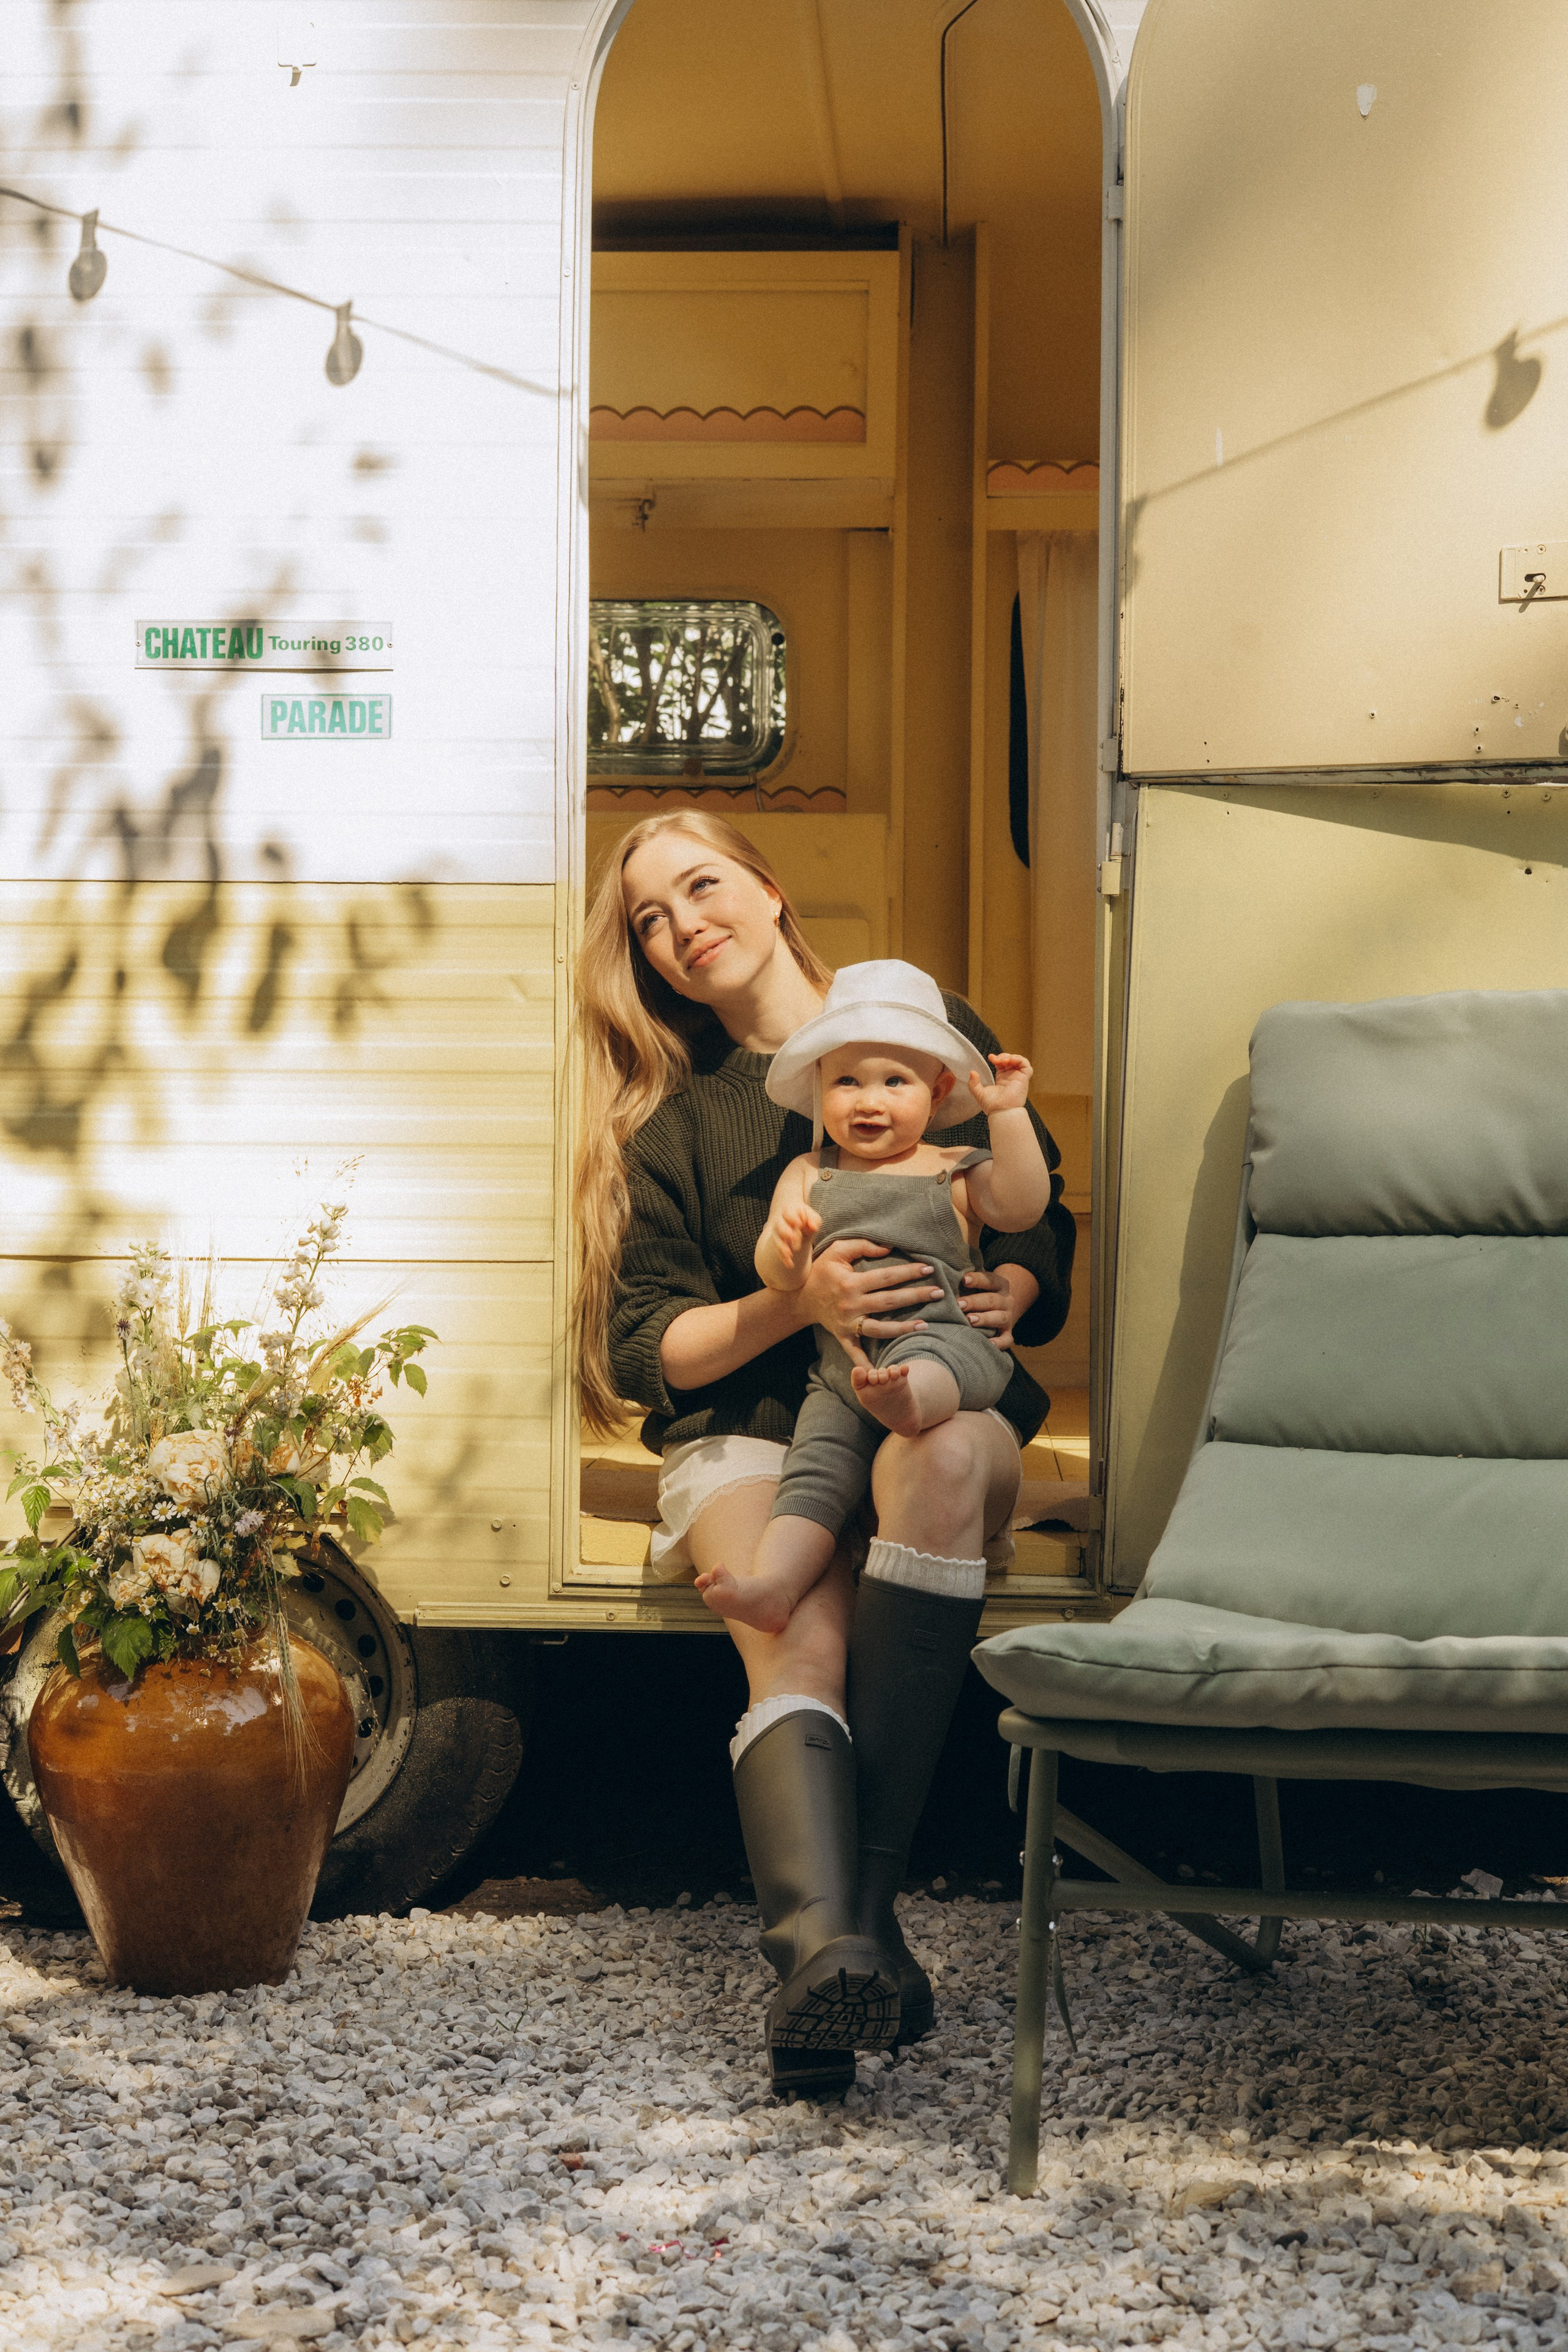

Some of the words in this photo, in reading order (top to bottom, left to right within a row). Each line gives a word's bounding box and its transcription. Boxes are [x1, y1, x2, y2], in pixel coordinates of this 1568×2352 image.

[145, 627, 263, 660] CHATEAU
[268, 636, 341, 655] Touring
[345, 636, 384, 651] 380
[270, 700, 383, 734] PARADE
